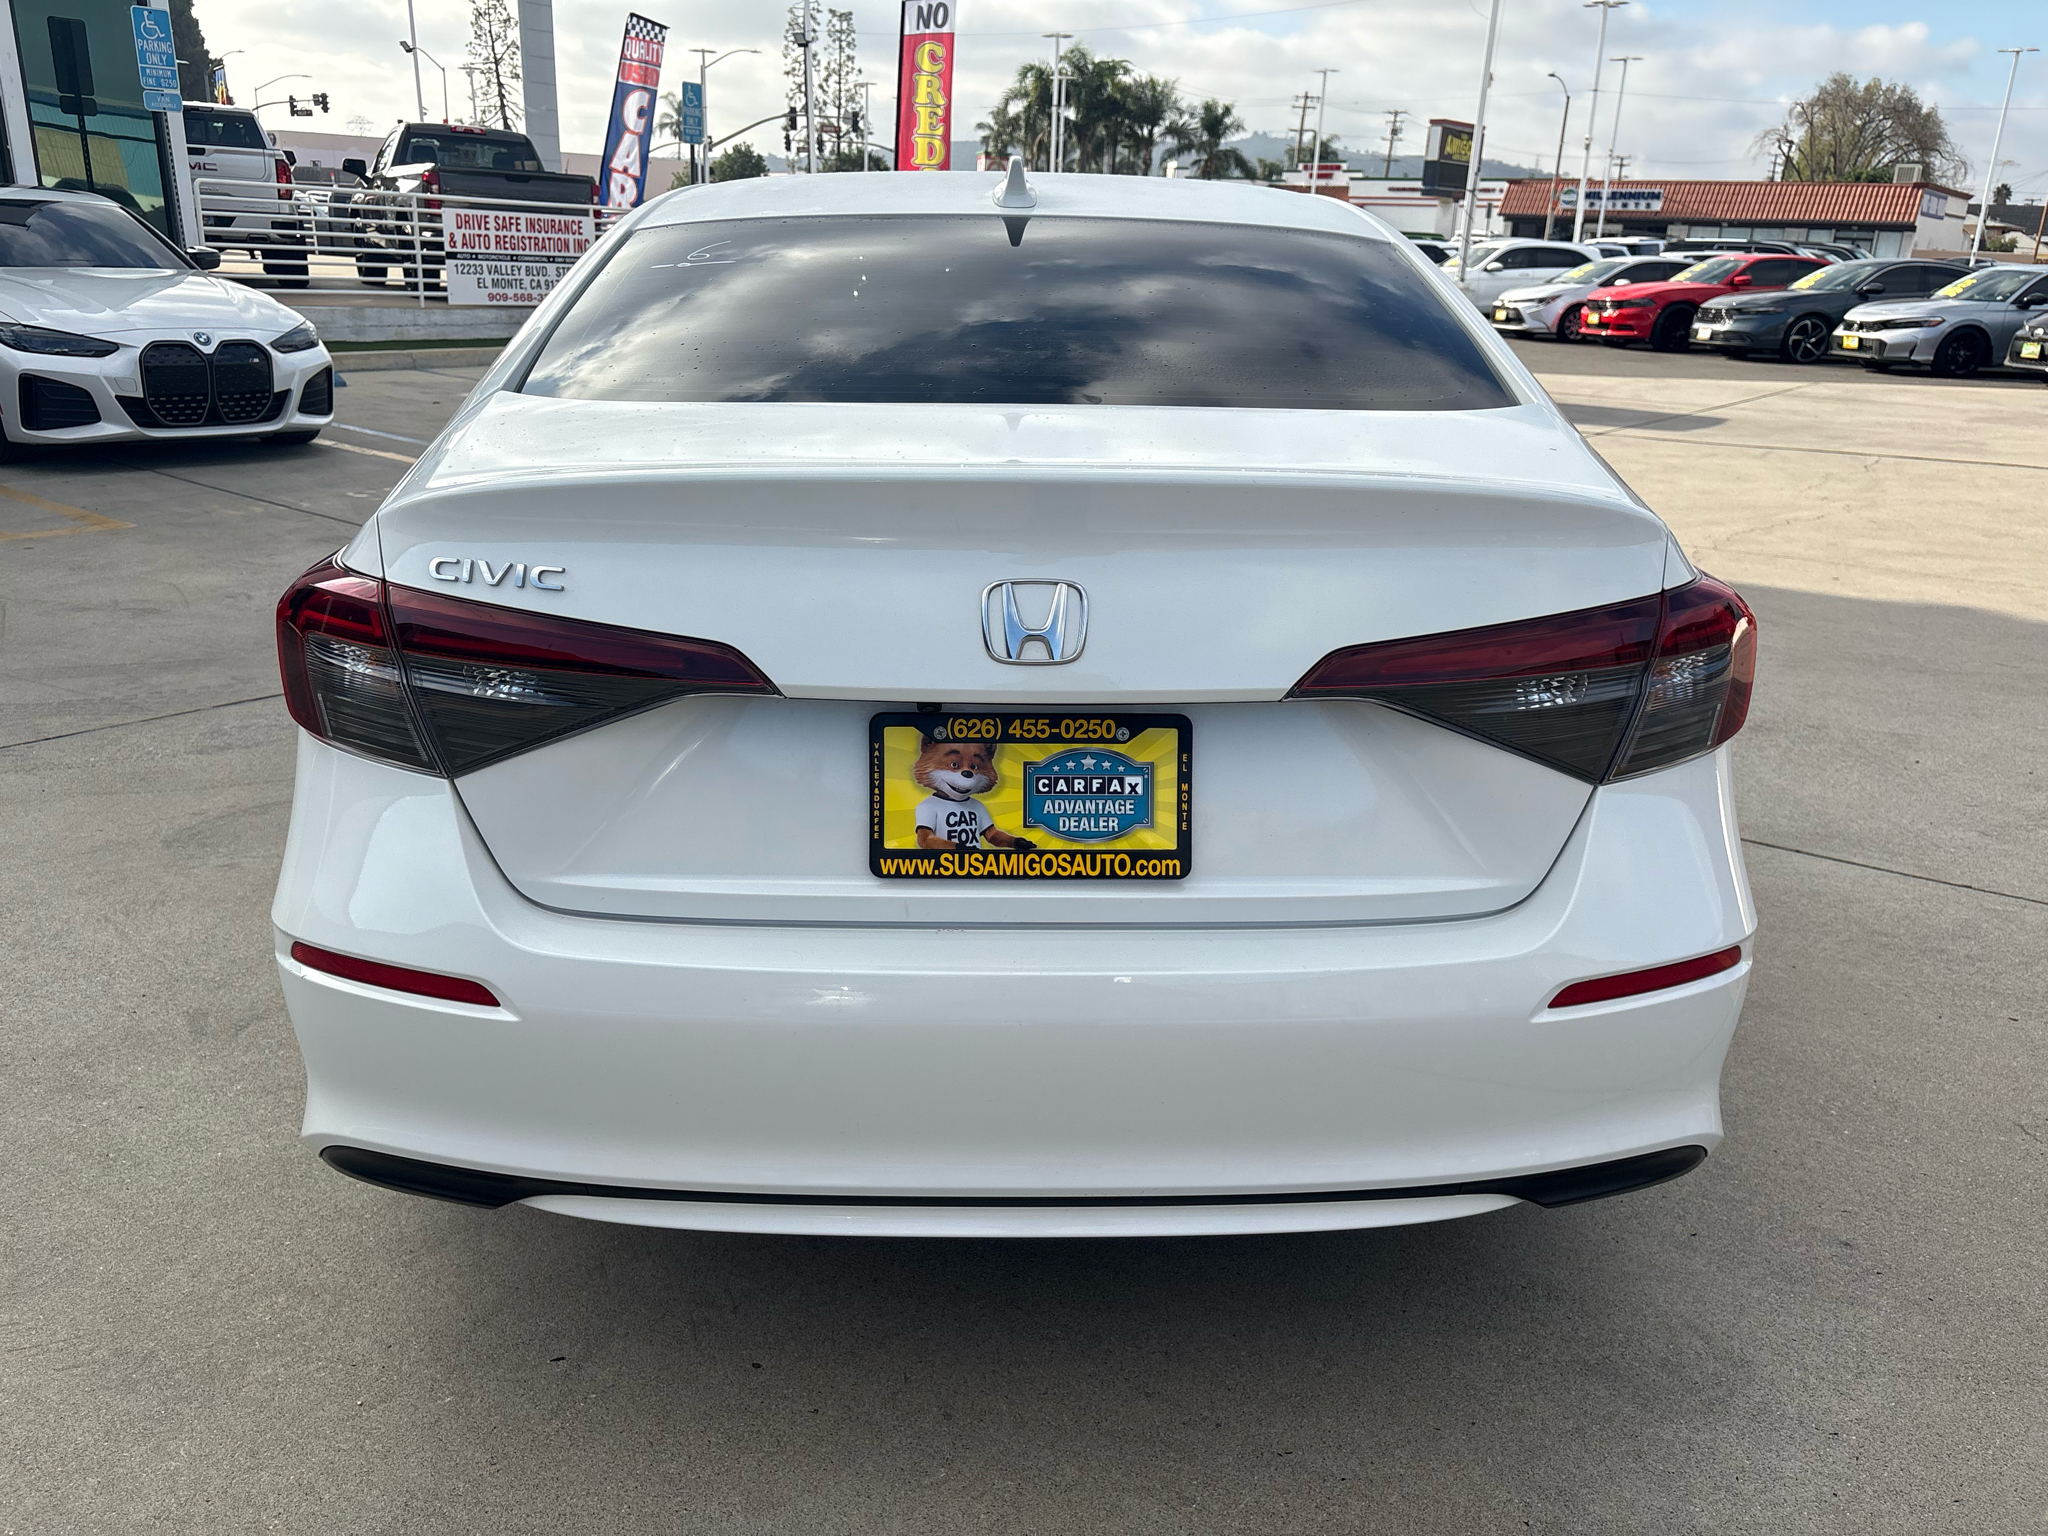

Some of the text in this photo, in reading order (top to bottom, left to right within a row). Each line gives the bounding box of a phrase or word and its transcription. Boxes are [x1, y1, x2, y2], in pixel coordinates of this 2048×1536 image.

[916, 2, 949, 31] NO
[137, 39, 172, 54] PARKING
[623, 38, 664, 63] QUALITY
[146, 52, 167, 65] ONLY
[145, 68, 172, 78] MINIMUM
[620, 61, 660, 87] USED
[143, 77, 177, 88] FINE $250
[913, 41, 947, 171] CRED
[607, 88, 651, 214] CAR
[189, 161, 218, 171] MC
[1588, 201, 1652, 209] PINTS
[455, 213, 583, 236] DRIVE SAFE INSURANCE
[449, 232, 590, 254] & AUTO REGISTRATION INC
[454, 263, 484, 275] 12233
[486, 264, 522, 276] VALLEY
[525, 266, 550, 278] BLVD.
[477, 277, 488, 289] EL
[492, 278, 527, 291] MONTE,
[530, 280, 541, 290] CA
[428, 556, 565, 591] CIVIC
[947, 717, 1116, 740] (626) 455-0250
[1182, 754, 1188, 771] EL
[1036, 777, 1142, 795] CARFAX
[1043, 800, 1135, 814] ADVANTAGE
[945, 811, 978, 828] CAR
[1059, 817, 1119, 832] DEALER
[947, 828, 980, 845] FOX
[880, 853, 1181, 876] www.SUSAMIGOSAUTO.com
